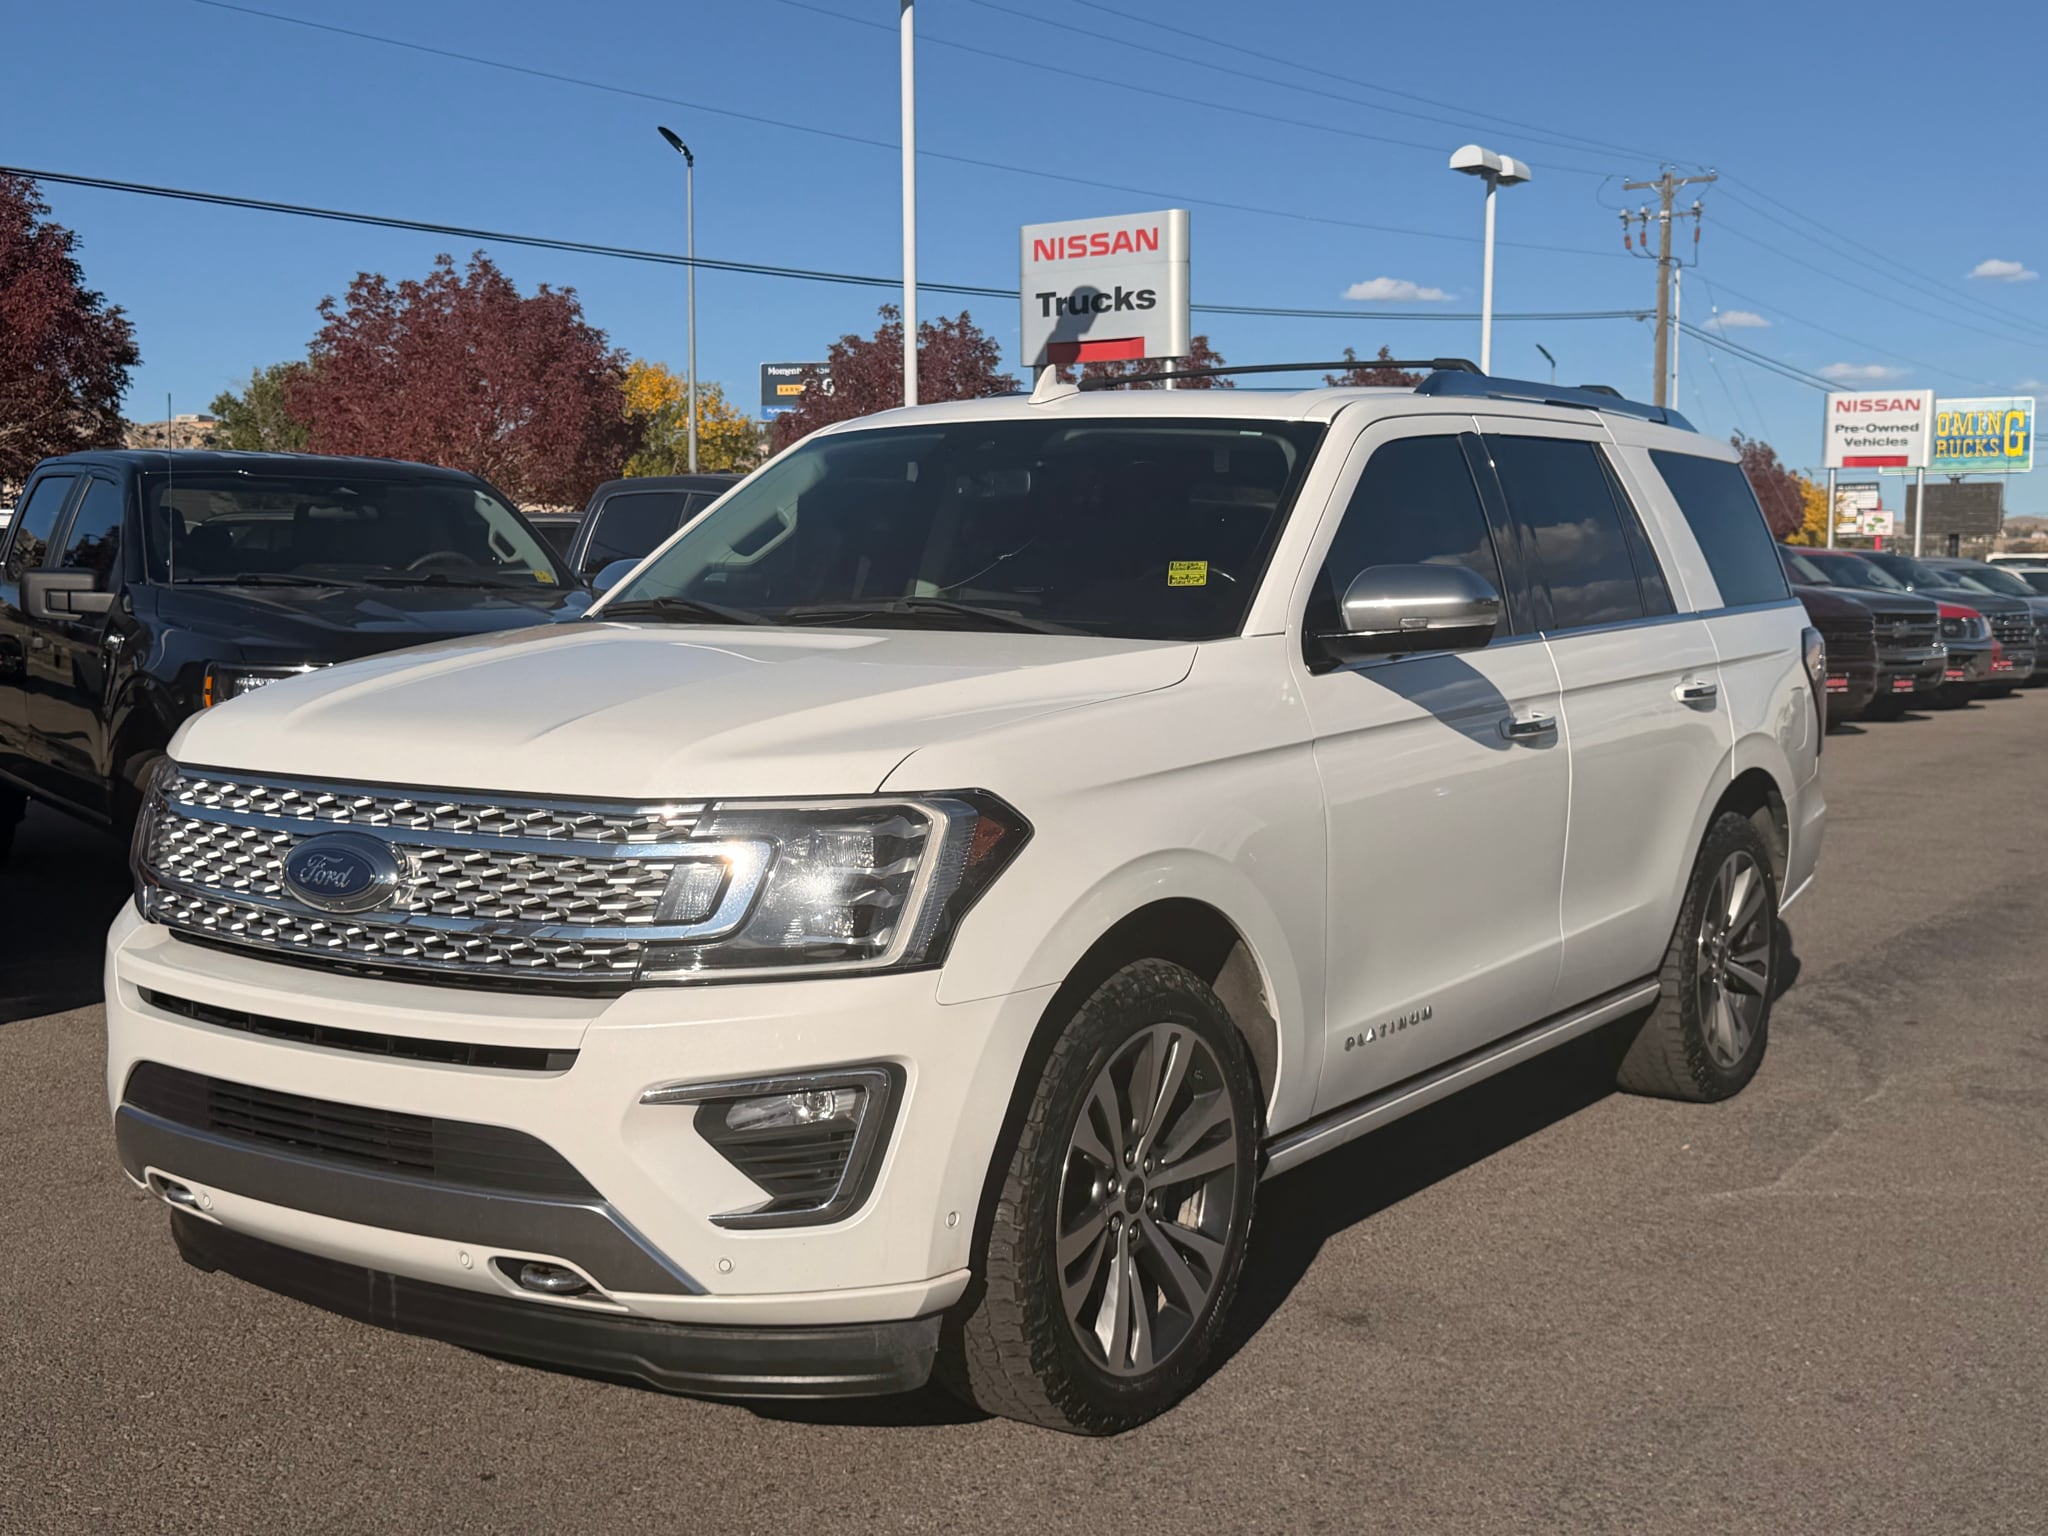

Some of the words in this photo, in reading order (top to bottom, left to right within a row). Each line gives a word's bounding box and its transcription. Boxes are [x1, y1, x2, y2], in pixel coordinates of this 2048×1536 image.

[1033, 227, 1159, 262] NISSAN
[1035, 286, 1157, 318] Trucks
[1836, 398, 1921, 413] NISSAN
[1835, 422, 1920, 434] Pre-Owned
[1843, 437, 1909, 448] Vehicles
[1935, 438, 2001, 458] RUCKS
[300, 854, 355, 888] Ford
[1344, 1005, 1433, 1052] PLATINUM
